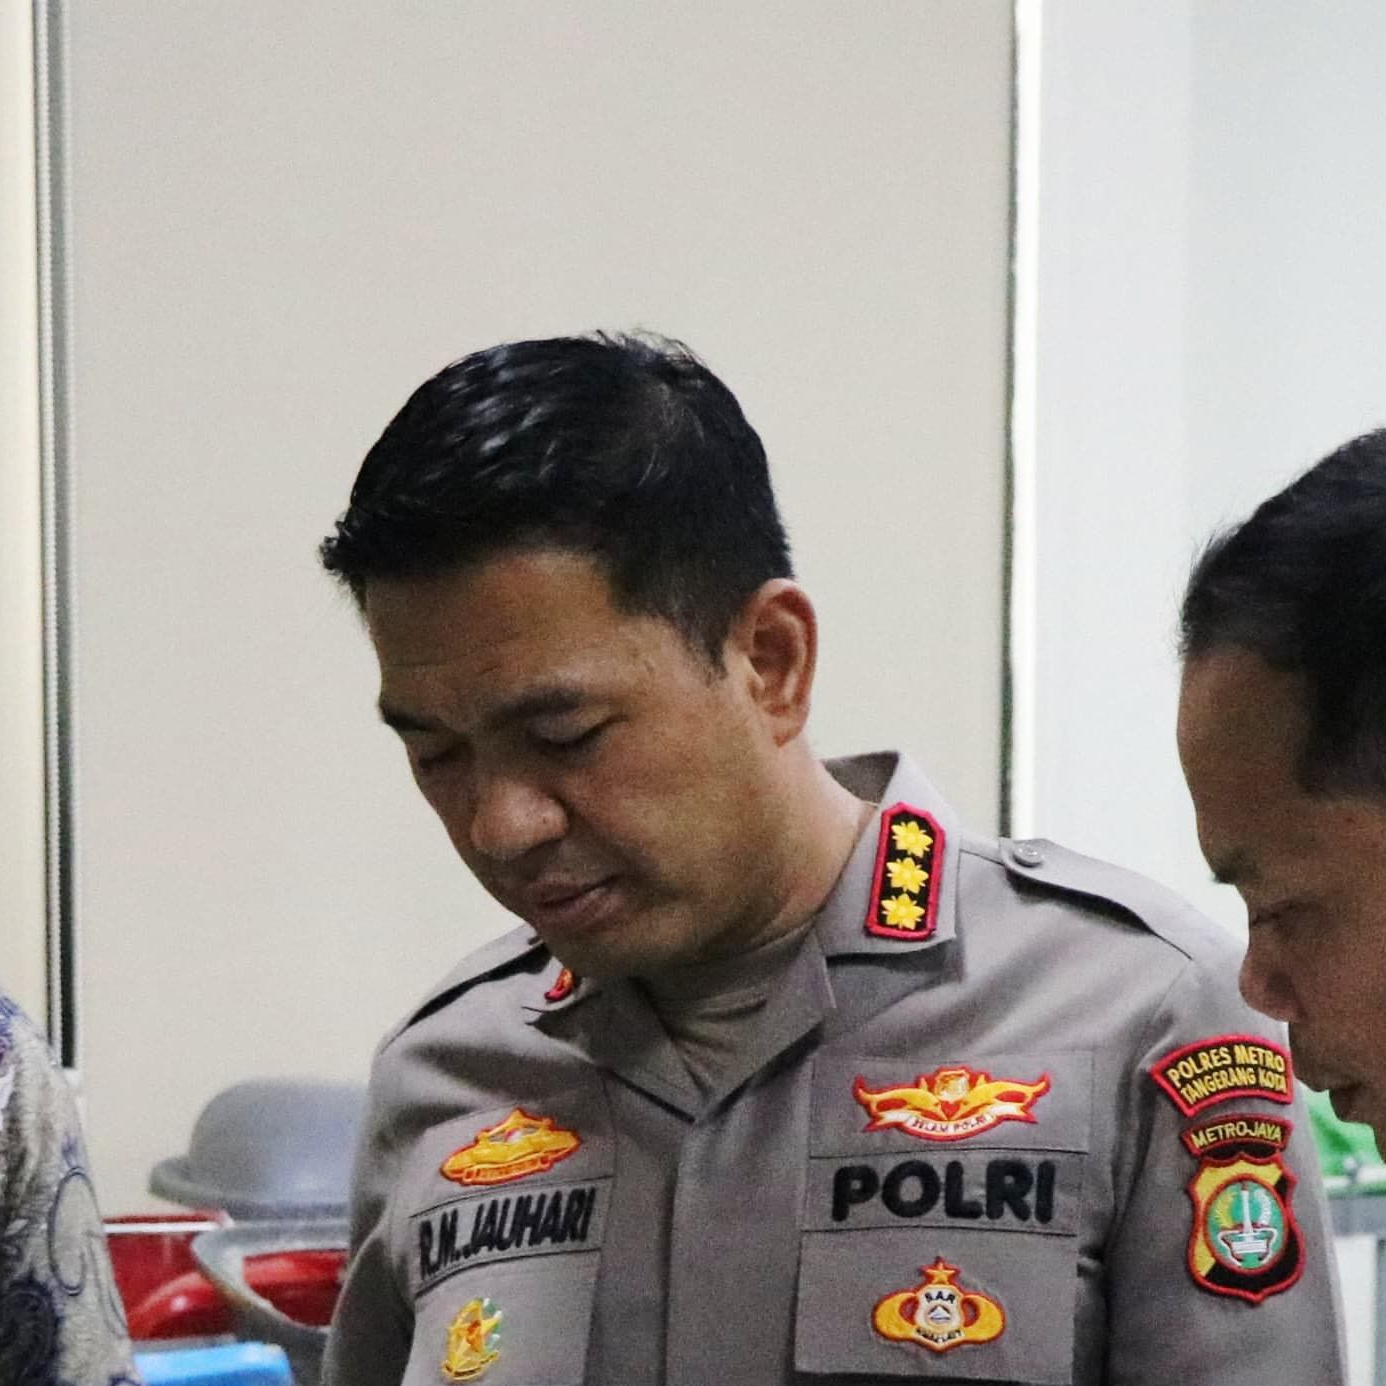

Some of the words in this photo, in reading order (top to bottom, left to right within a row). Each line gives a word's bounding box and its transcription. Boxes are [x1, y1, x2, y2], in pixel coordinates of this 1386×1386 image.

[1167, 1046, 1232, 1088] POLRES
[1233, 1044, 1285, 1074] METRO
[1180, 1067, 1256, 1105] TANGERANG
[1258, 1069, 1287, 1094] KOTA
[831, 1159, 1056, 1225] POLRI
